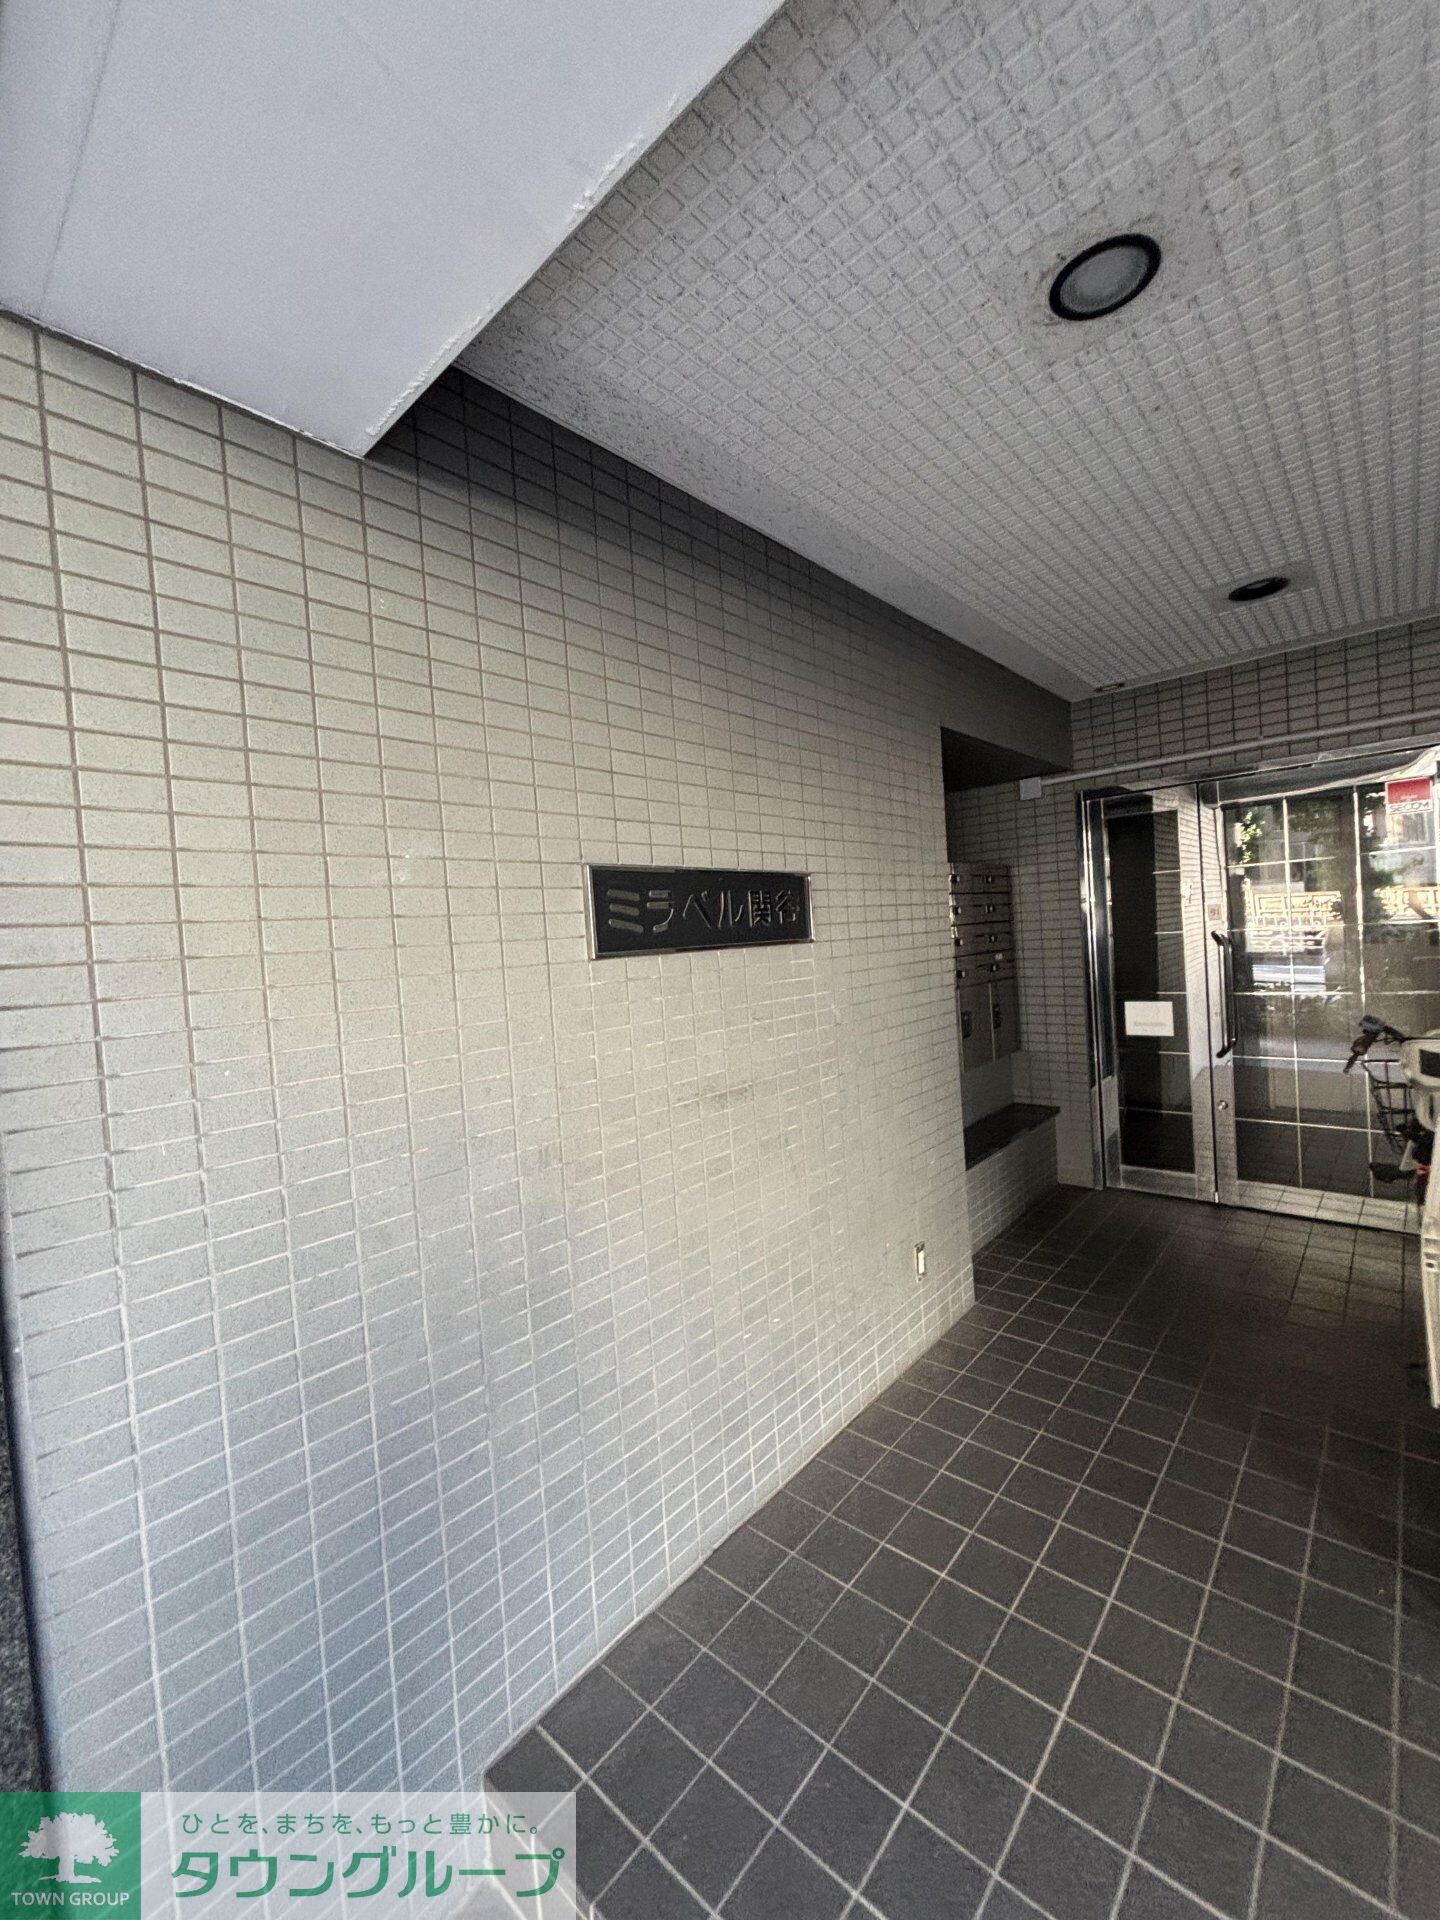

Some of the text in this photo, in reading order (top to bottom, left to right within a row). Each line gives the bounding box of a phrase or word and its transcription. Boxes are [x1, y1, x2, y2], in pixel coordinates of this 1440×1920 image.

[606, 889, 800, 934] ミラベル関谷
